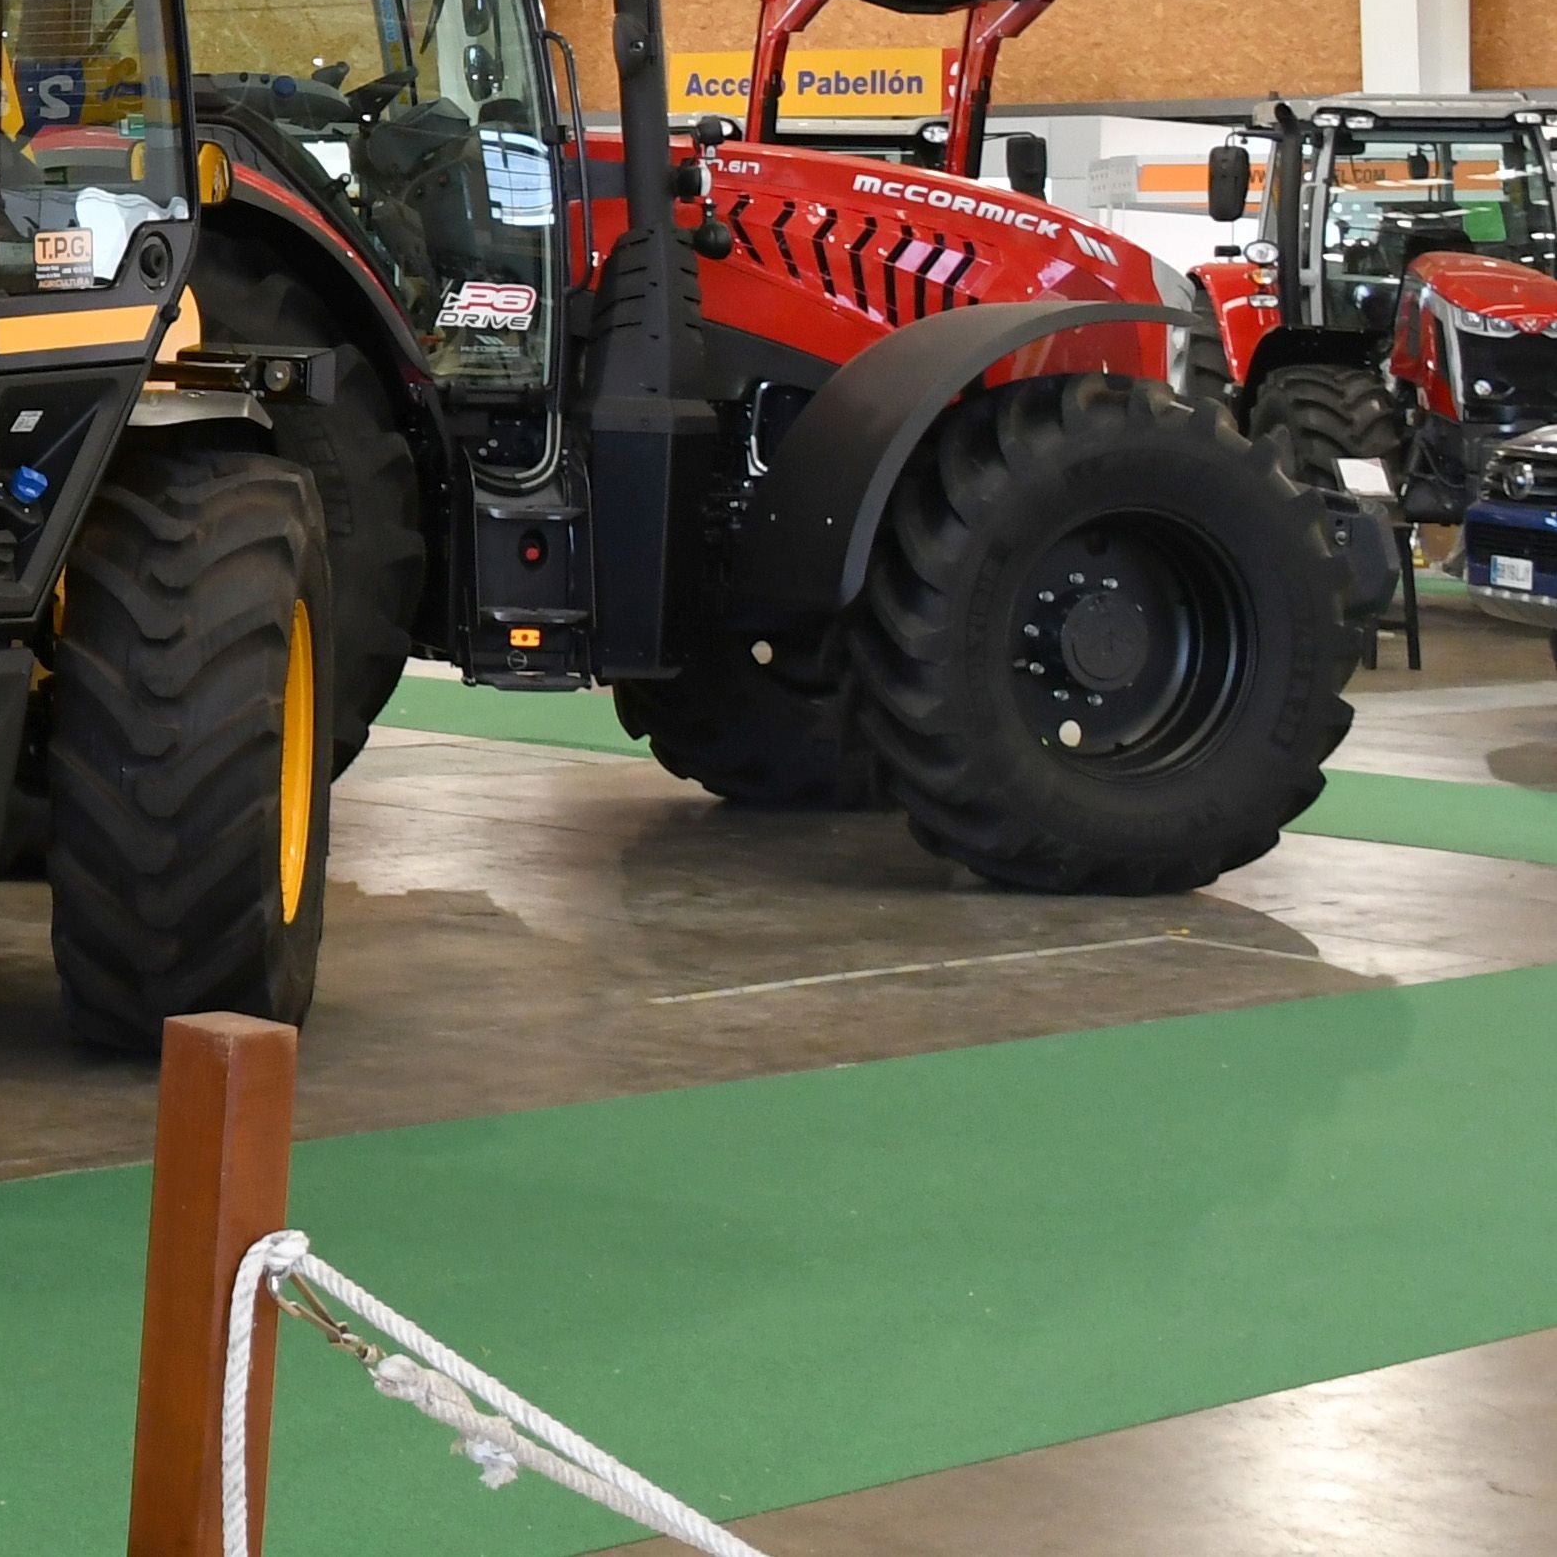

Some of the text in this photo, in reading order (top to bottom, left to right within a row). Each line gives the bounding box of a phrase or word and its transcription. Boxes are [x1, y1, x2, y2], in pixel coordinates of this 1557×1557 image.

[797, 69, 924, 96] Pabellón
[37, 235, 90, 259] T.P.G.
[439, 312, 529, 328] DRIVE
